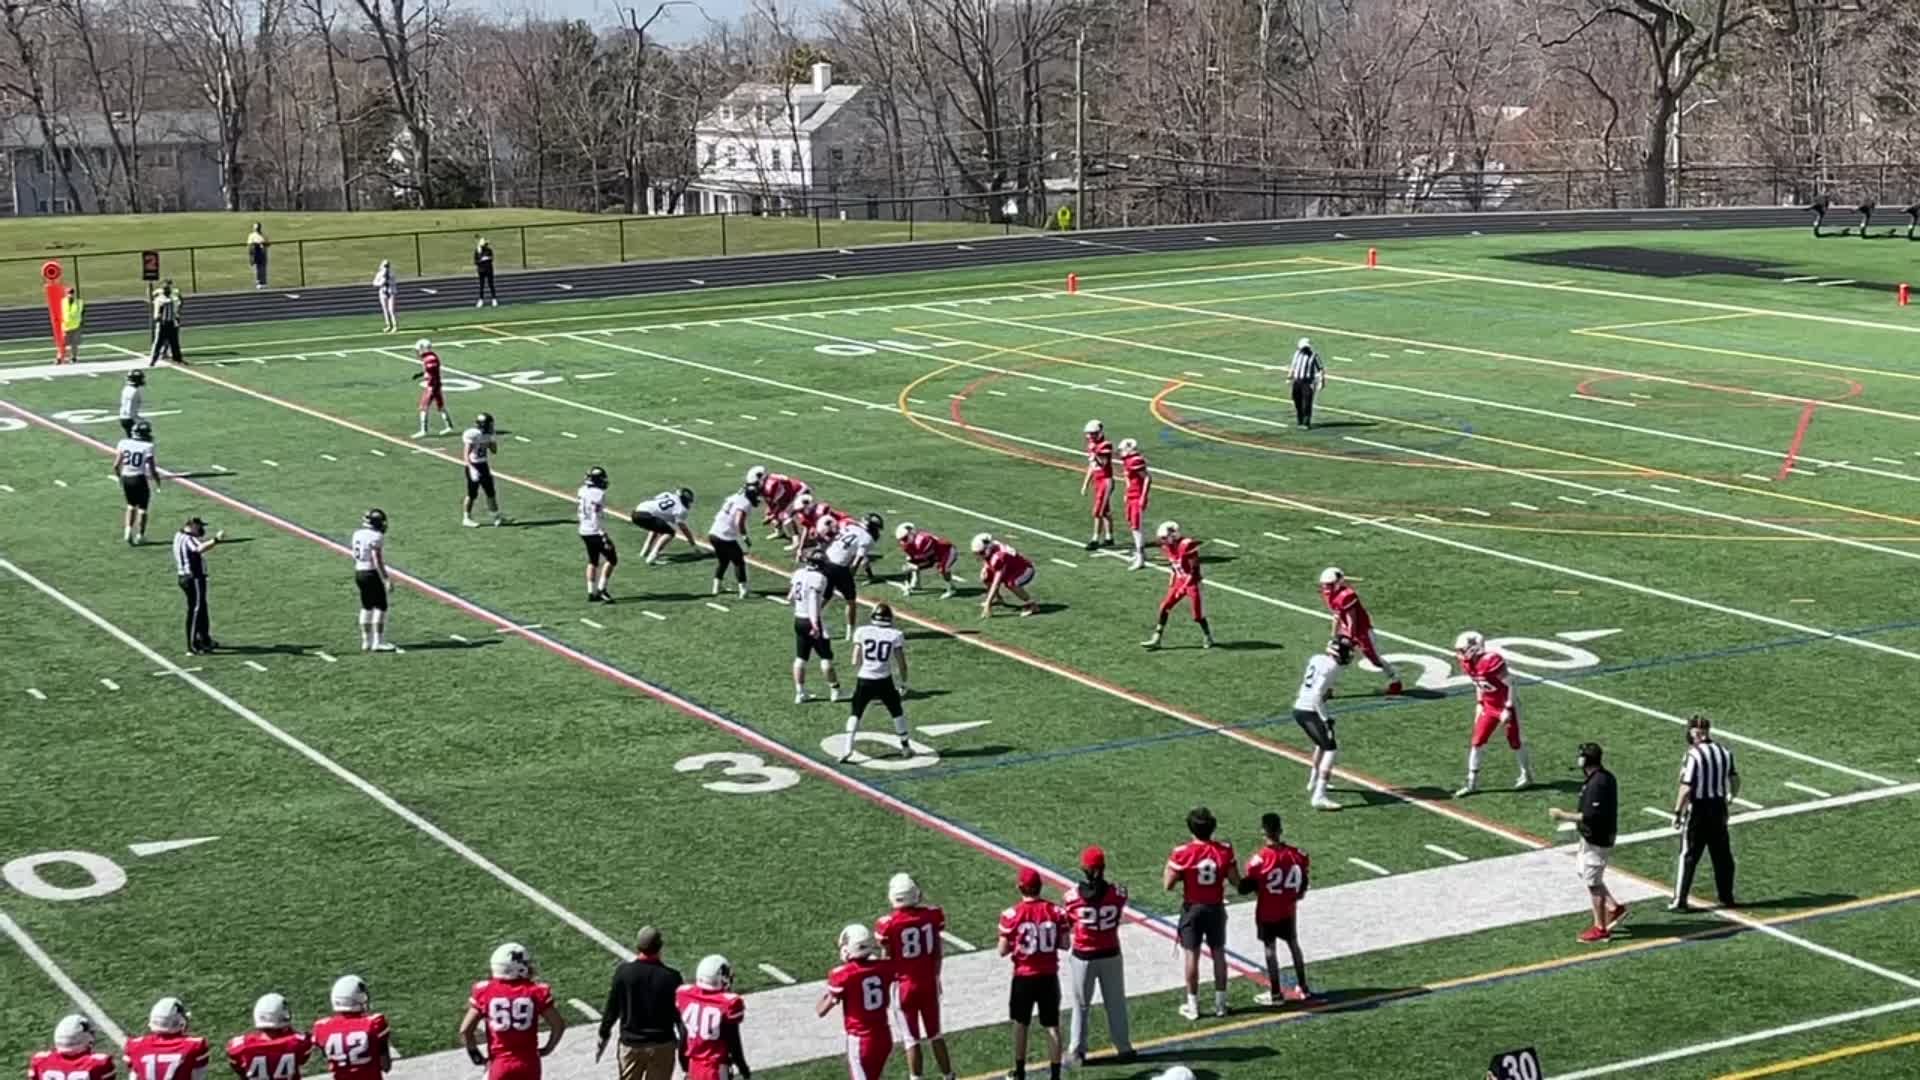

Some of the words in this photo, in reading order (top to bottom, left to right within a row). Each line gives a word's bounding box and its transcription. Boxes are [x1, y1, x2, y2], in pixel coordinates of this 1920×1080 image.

[864, 639, 892, 662] 20
[1358, 636, 1600, 689] 20
[674, 731, 940, 793] 30
[1197, 858, 1217, 885] 8
[1265, 864, 1302, 894] 24
[1079, 905, 1118, 931] 22
[901, 922, 934, 958] 81
[1017, 921, 1056, 955] 30
[862, 975, 883, 1010] 6
[488, 997, 534, 1031] 69
[682, 1003, 721, 1040] 40
[325, 1031, 372, 1066] 42
[140, 1053, 183, 1080] 17
[247, 1053, 297, 1080] 44
[1503, 1052, 1537, 1080] 30
